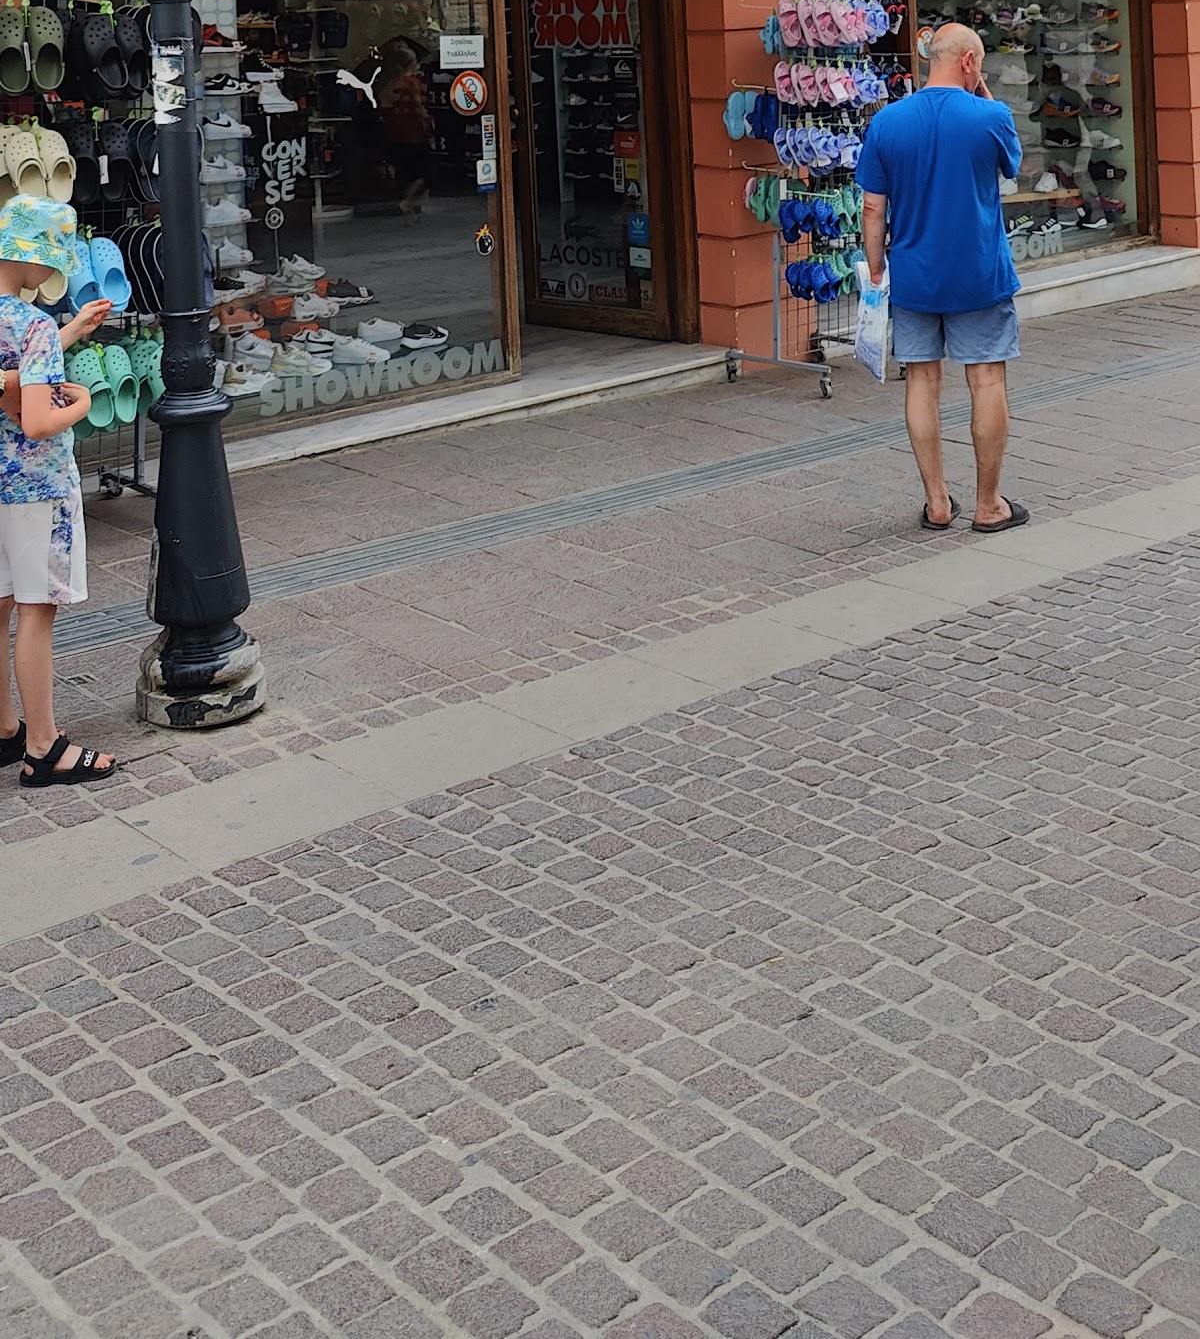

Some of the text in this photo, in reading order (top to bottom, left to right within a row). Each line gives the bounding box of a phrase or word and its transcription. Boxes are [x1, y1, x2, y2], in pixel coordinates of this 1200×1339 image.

[261, 136, 307, 162] CON
[265, 177, 297, 205] SE
[538, 243, 625, 268] LACOSTE
[260, 338, 505, 417] SHOWROOM
